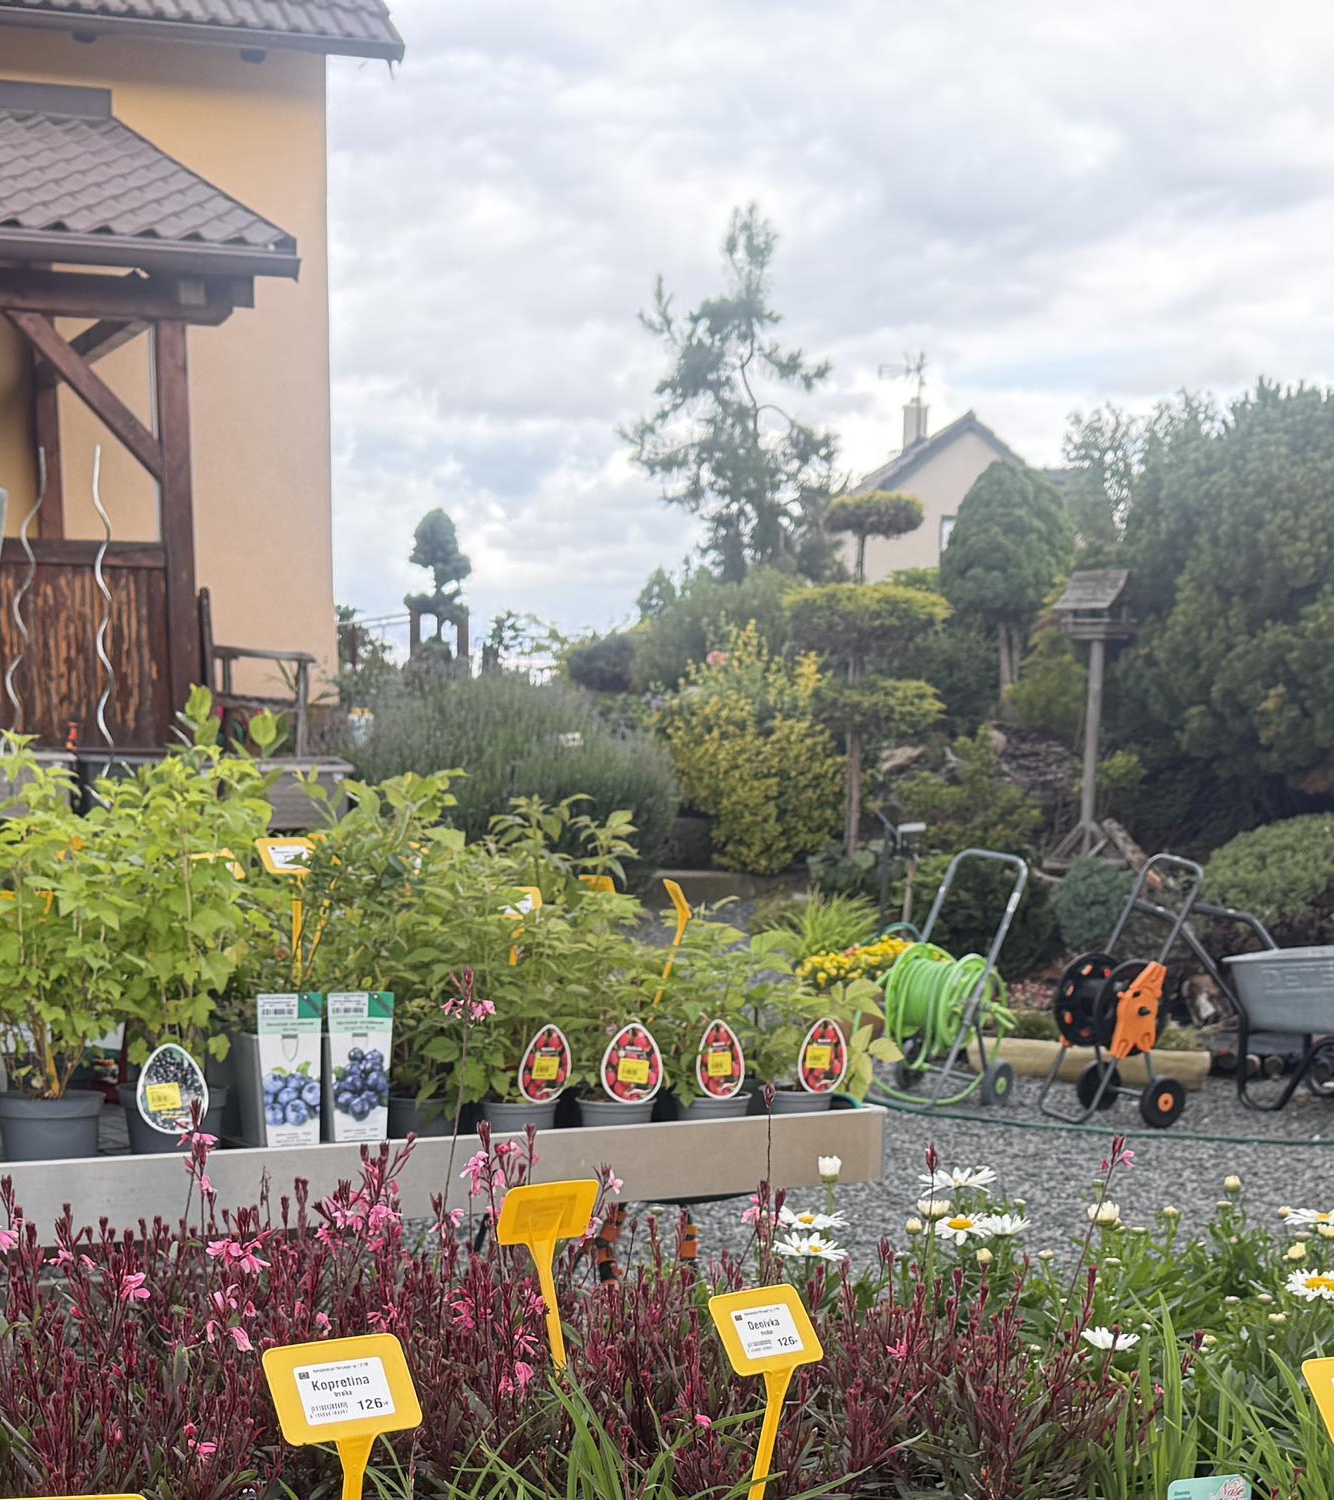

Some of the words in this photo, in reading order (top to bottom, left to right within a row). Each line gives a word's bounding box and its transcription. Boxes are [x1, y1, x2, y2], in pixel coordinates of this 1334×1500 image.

[777, 1336, 795, 1347] 126
[311, 1374, 371, 1393] Kopretina
[356, 1397, 383, 1411] 126
